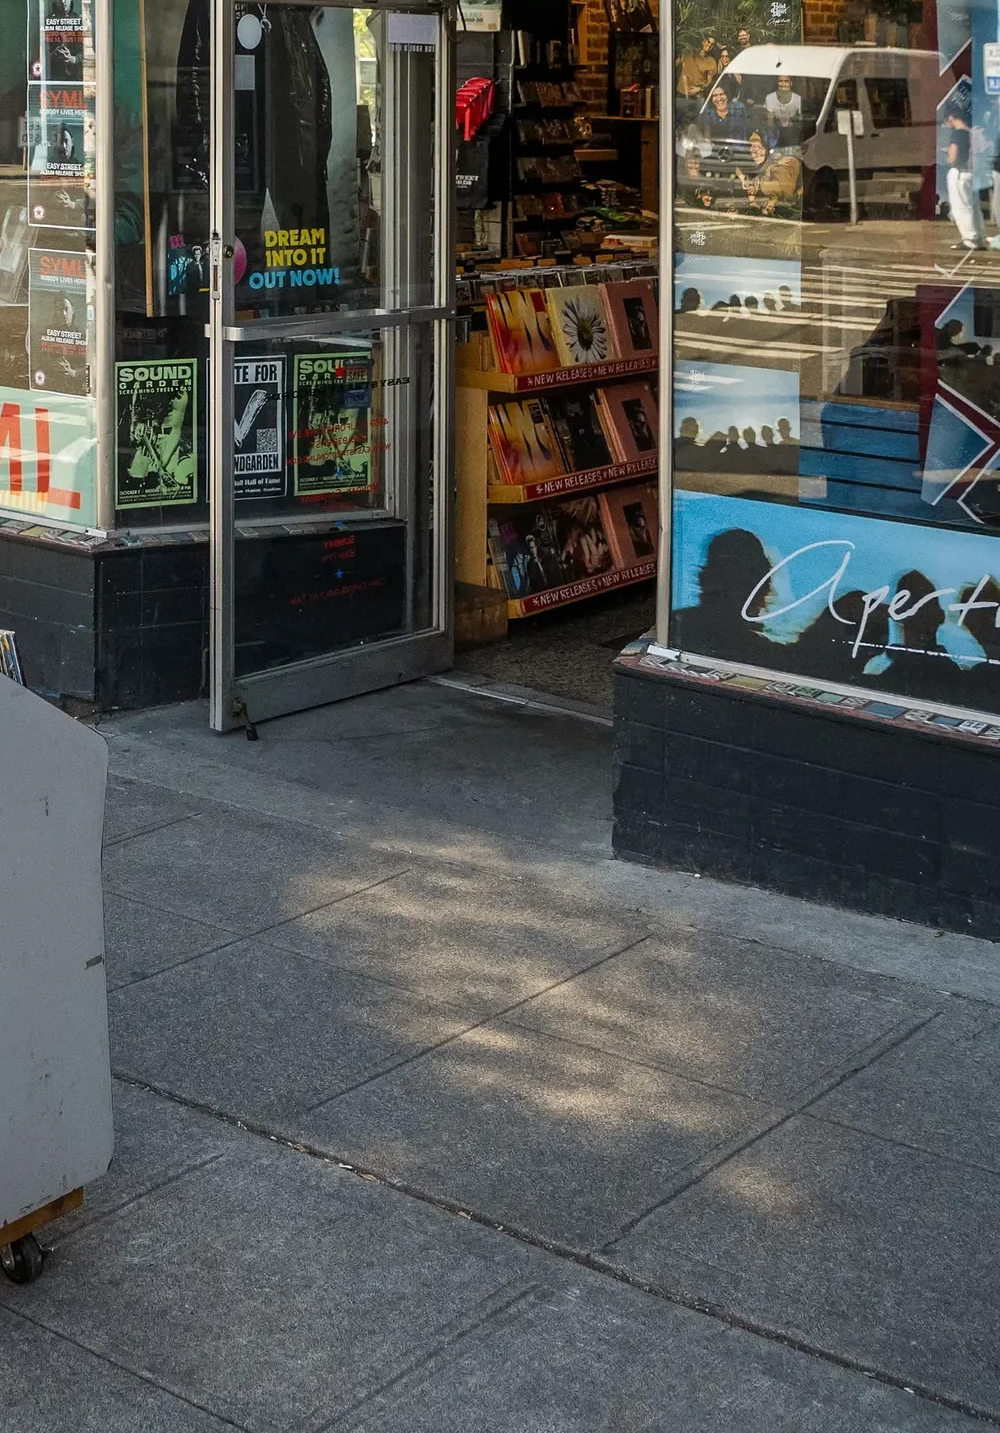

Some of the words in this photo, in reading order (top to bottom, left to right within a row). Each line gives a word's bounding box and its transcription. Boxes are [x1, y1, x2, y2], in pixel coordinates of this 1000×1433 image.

[39, 90, 88, 109] SYML
[264, 227, 326, 248] DREAM
[40, 256, 87, 278] SYML
[265, 248, 307, 267] INTO
[310, 247, 326, 265] IT
[249, 270, 286, 290] OUT
[289, 267, 340, 287] NOW!
[47, 329, 60, 337] EASY
[61, 331, 82, 339] STREET
[119, 366, 192, 382] SOUND
[255, 364, 277, 381] FOR
[534, 372, 554, 386] NEW
[557, 367, 593, 383] RELEASES
[598, 363, 614, 378] NEW
[616, 358, 650, 373] RELEASES
[119, 380, 192, 390] GARDEN
[544, 480, 563, 494] NEW
[565, 471, 601, 490] RELEASES
[608, 464, 625, 478] NEW
[540, 590, 559, 605] NEW
[560, 579, 597, 598] RELEASES
[602, 572, 621, 587] NEW
[622, 562, 656, 580] RELEASES
[741, 539, 1000, 659] Apert
